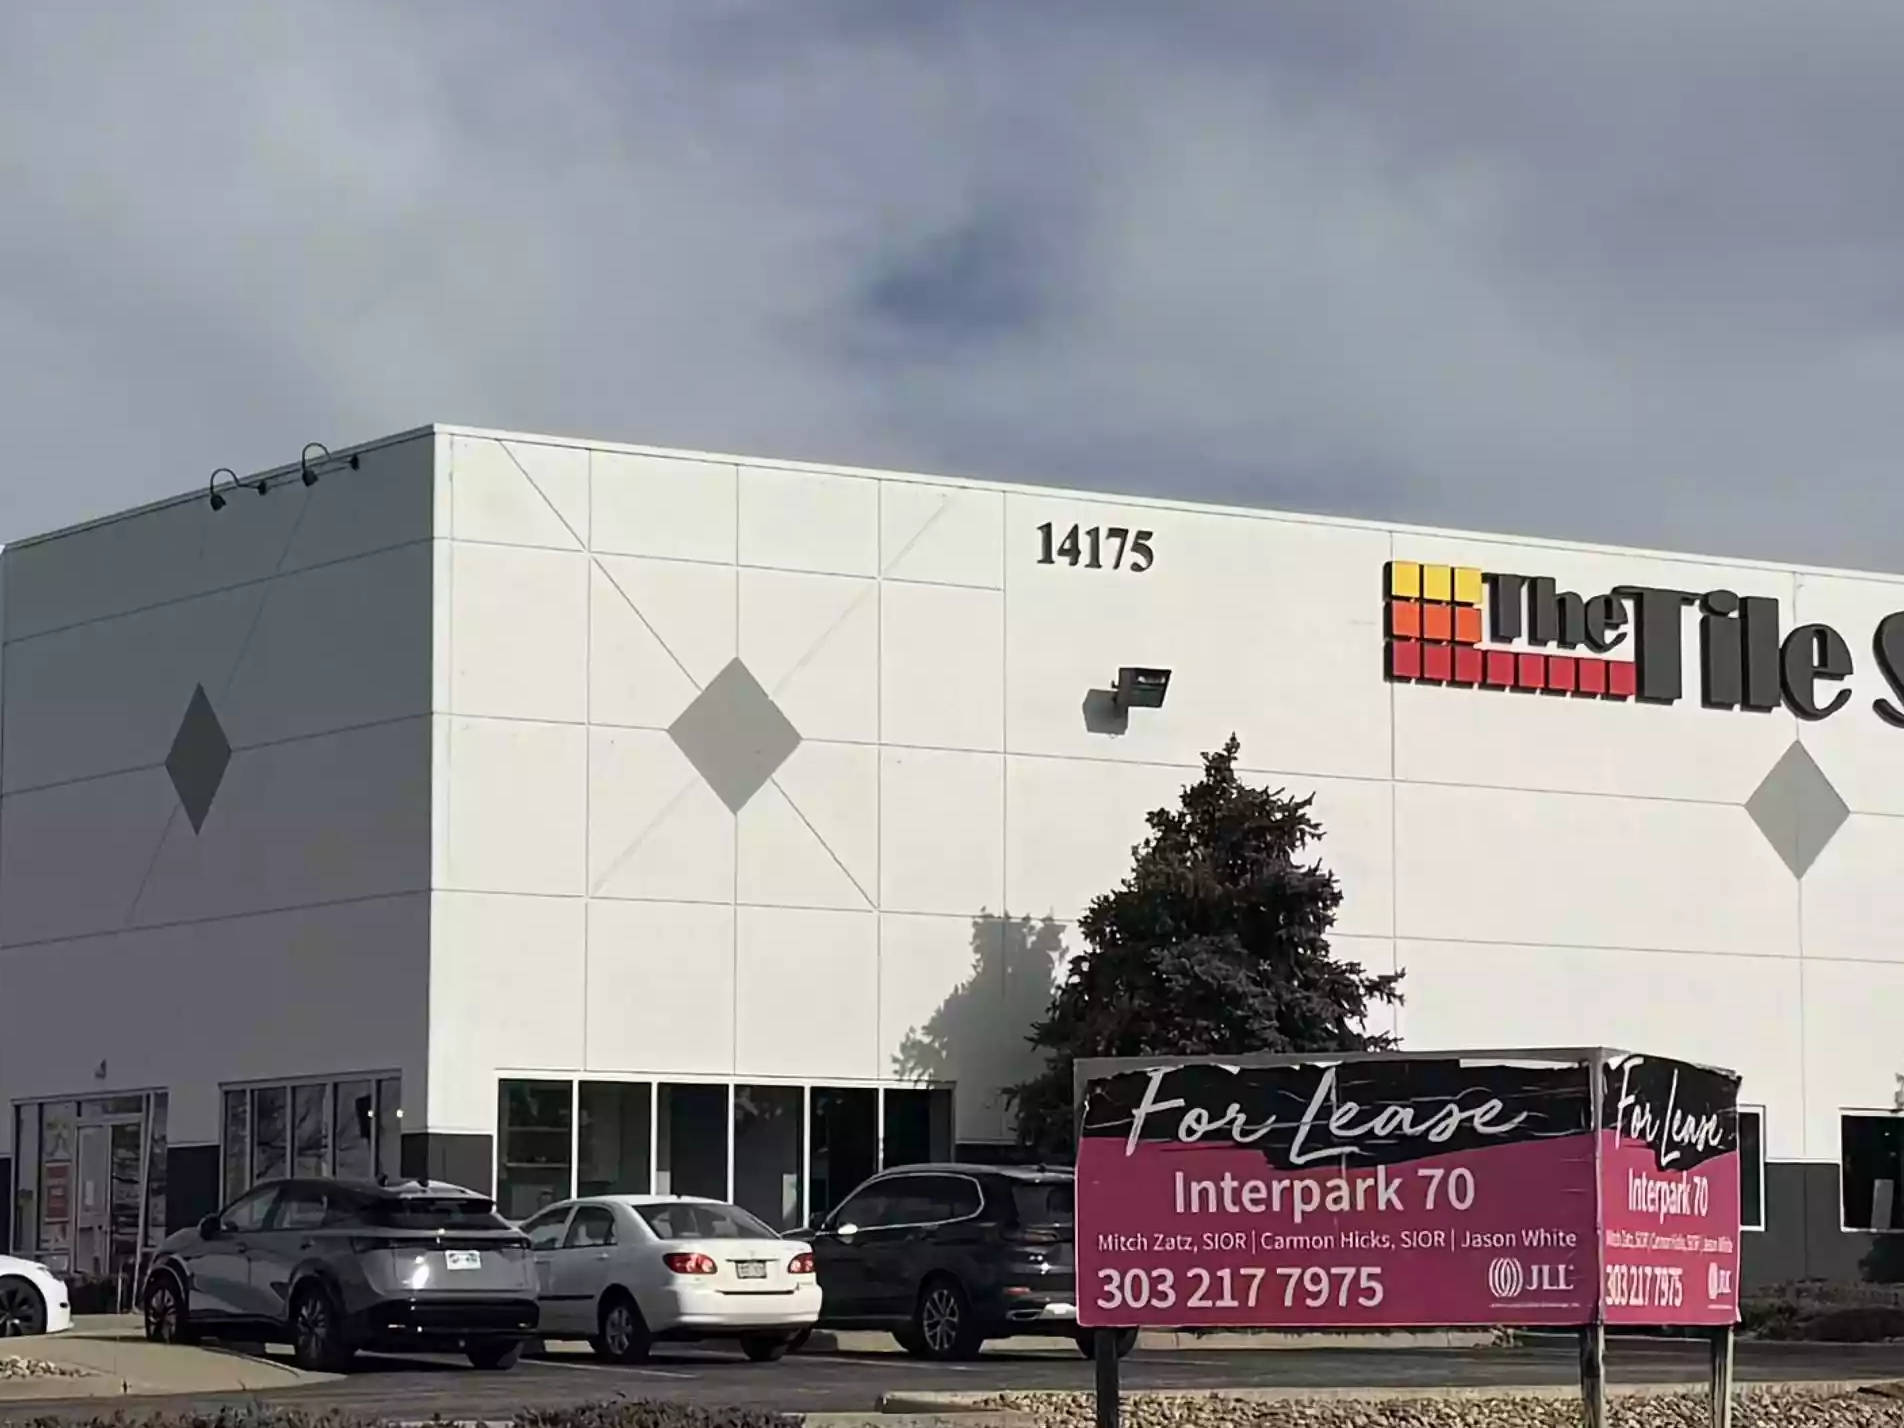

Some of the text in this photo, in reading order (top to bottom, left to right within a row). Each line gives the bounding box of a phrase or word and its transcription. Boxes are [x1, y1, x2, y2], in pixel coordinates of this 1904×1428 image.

[1036, 521, 1154, 572] 14175
[1481, 571, 1628, 653] The
[1612, 585, 1854, 722] Tile
[1126, 1066, 1528, 1164] For Lease
[1616, 1057, 1723, 1166] For Lease
[1175, 1165, 1476, 1224] Interpark 70
[1628, 1168, 1708, 1224] Interpark 70
[1098, 1232, 1148, 1252] Mitch
[1153, 1233, 1198, 1254] Zatz,
[1203, 1232, 1246, 1250] SIOR
[1261, 1232, 1335, 1250] Carmon
[1341, 1230, 1396, 1251] Hicks,
[1400, 1230, 1445, 1248] SIOR
[1461, 1230, 1516, 1248] Jason
[1521, 1228, 1577, 1247] White
[1096, 1266, 1384, 1309] 303 217 7975
[1526, 1264, 1574, 1291] JLL
[1605, 1264, 1683, 1307] 303 217 7975
